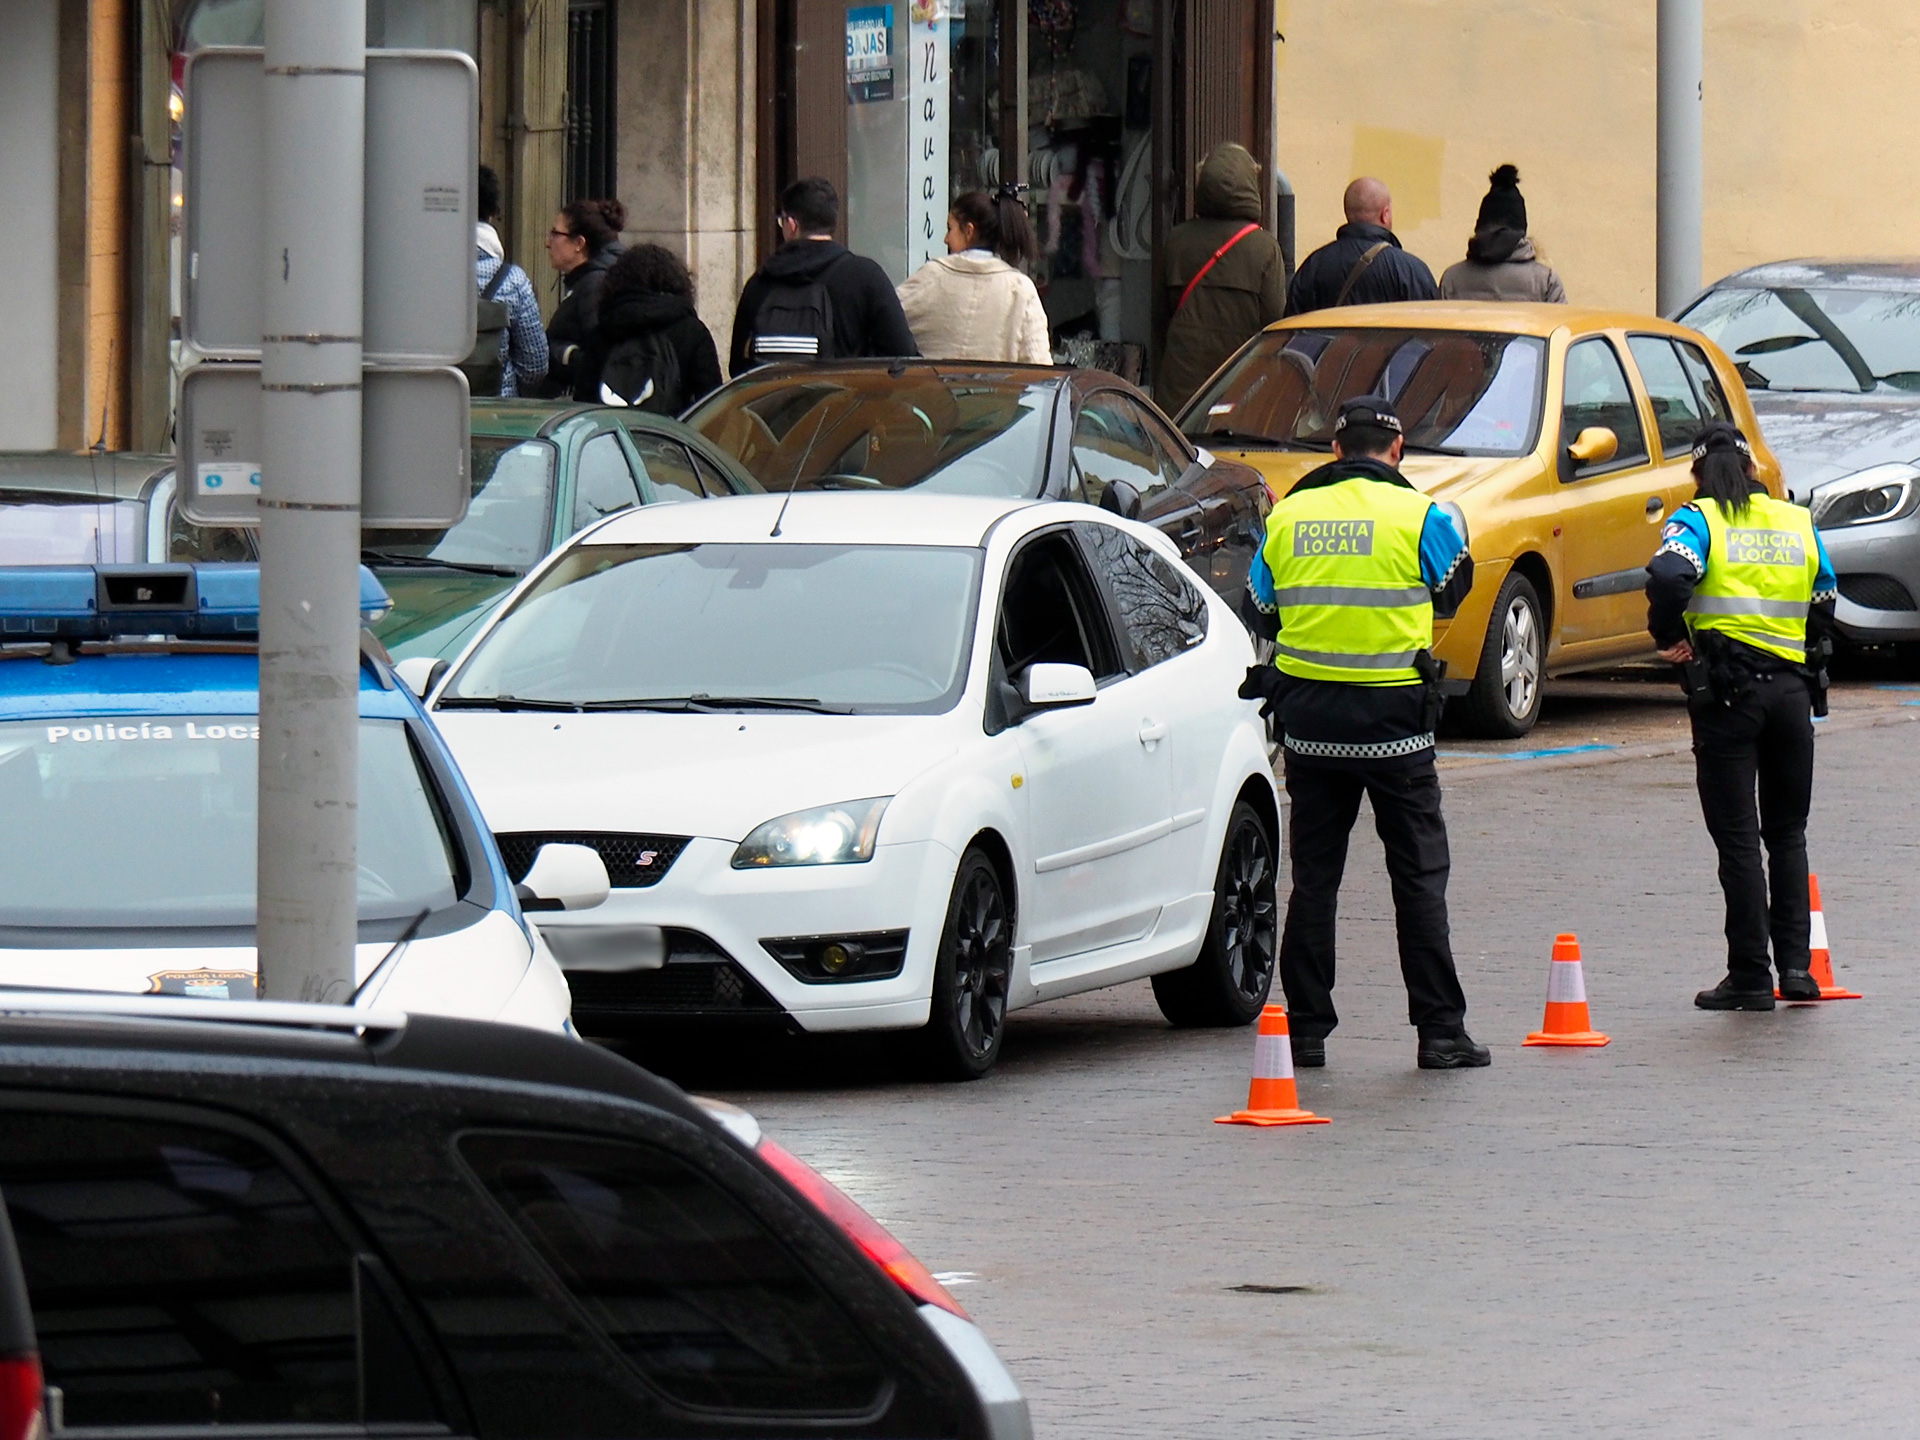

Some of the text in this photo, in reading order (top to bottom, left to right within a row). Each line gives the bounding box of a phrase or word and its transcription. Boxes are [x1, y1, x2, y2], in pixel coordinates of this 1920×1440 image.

[1298, 522, 1369, 538] POLICIA
[1304, 539, 1359, 554] LOCAL
[1730, 532, 1800, 548] POLICIA
[1738, 547, 1794, 563] LOCAL
[47, 722, 173, 743] Policía
